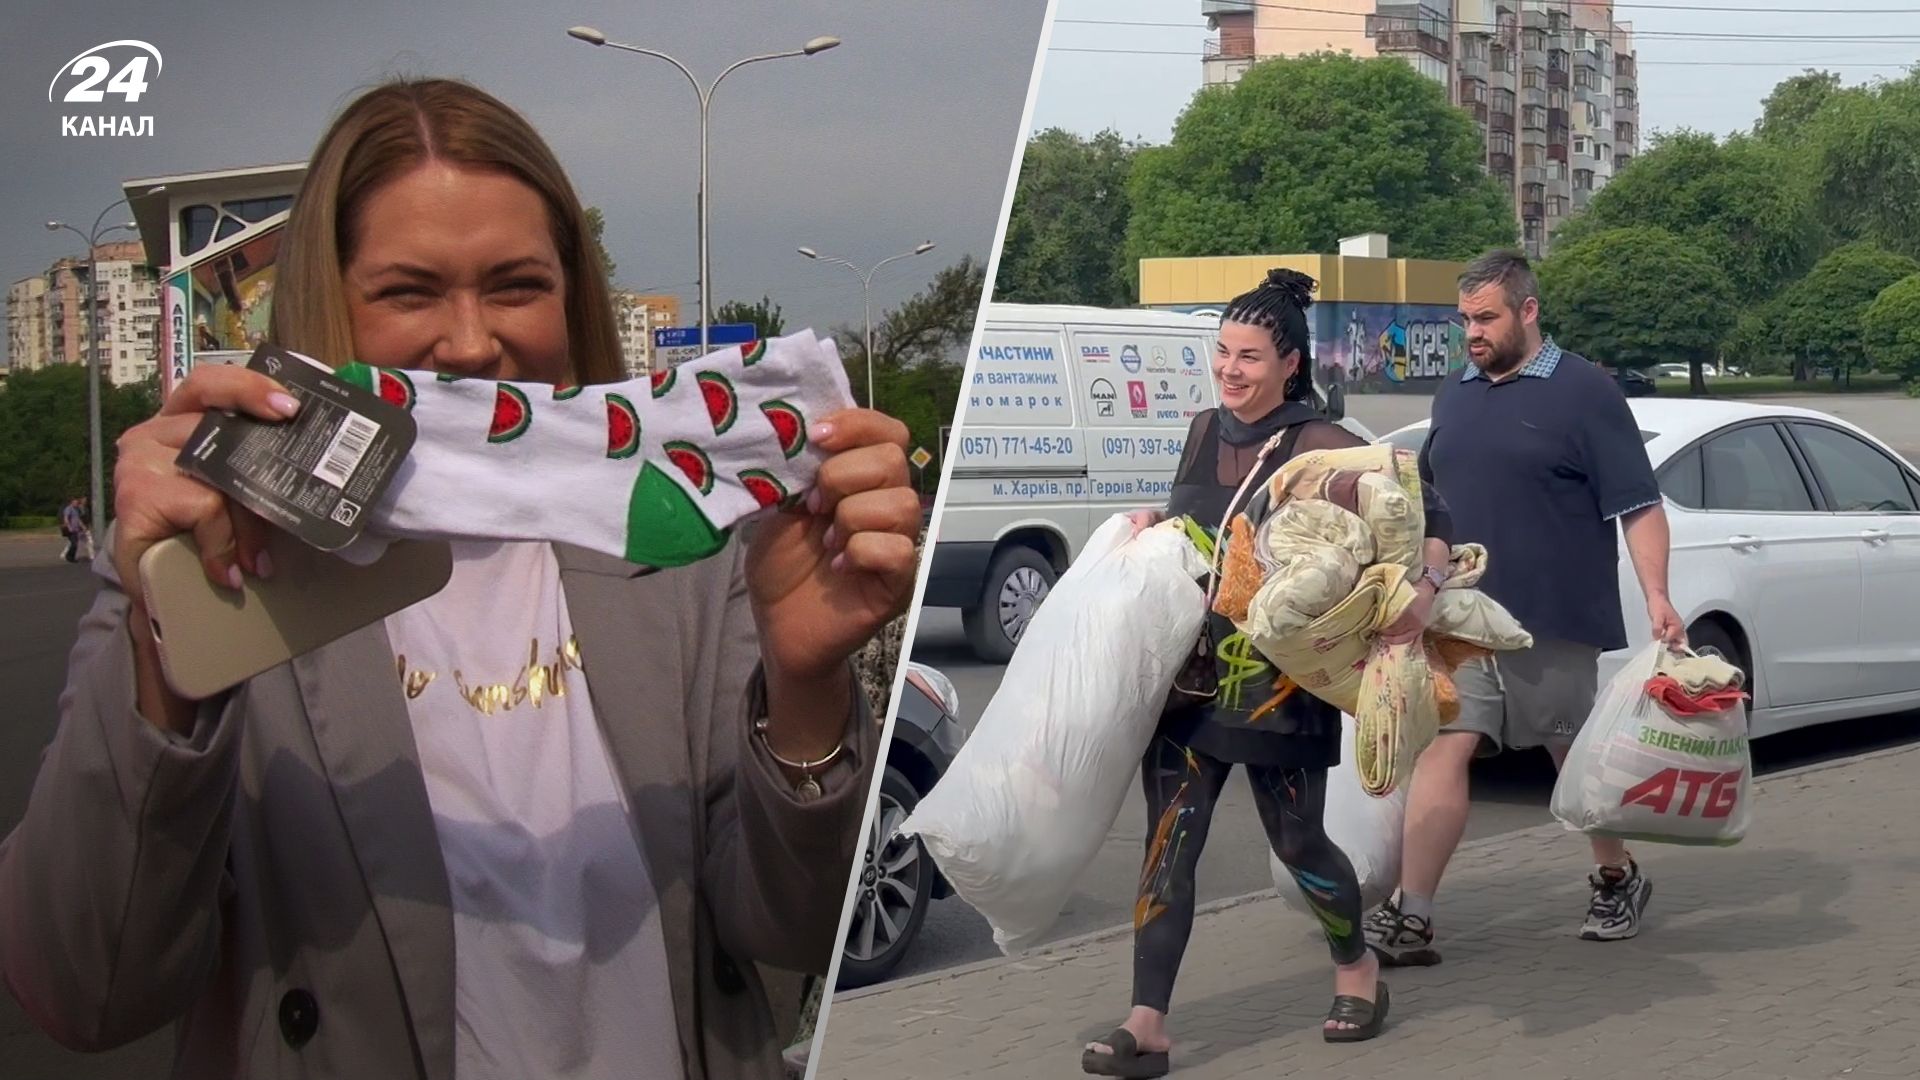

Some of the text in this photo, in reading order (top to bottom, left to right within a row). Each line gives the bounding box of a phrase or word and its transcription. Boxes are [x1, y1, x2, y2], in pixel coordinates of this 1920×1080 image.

[172, 303, 185, 379] АПТЕКА
[1405, 319, 1450, 377] 1925
[987, 372, 1059, 385] вантажних
[970, 396, 1063, 409] номарок
[1157, 410, 1179, 419] IVECO
[960, 437, 1073, 459] (057) 771-45-20
[1102, 438, 1182, 459] (097) 397-84
[993, 482, 1008, 495] м.
[1012, 479, 1062, 498] Харків,
[1066, 482, 1087, 499] пр.
[1136, 478, 1172, 496] Харко
[1638, 725, 1716, 757] ЗЕЛЕНИЙ
